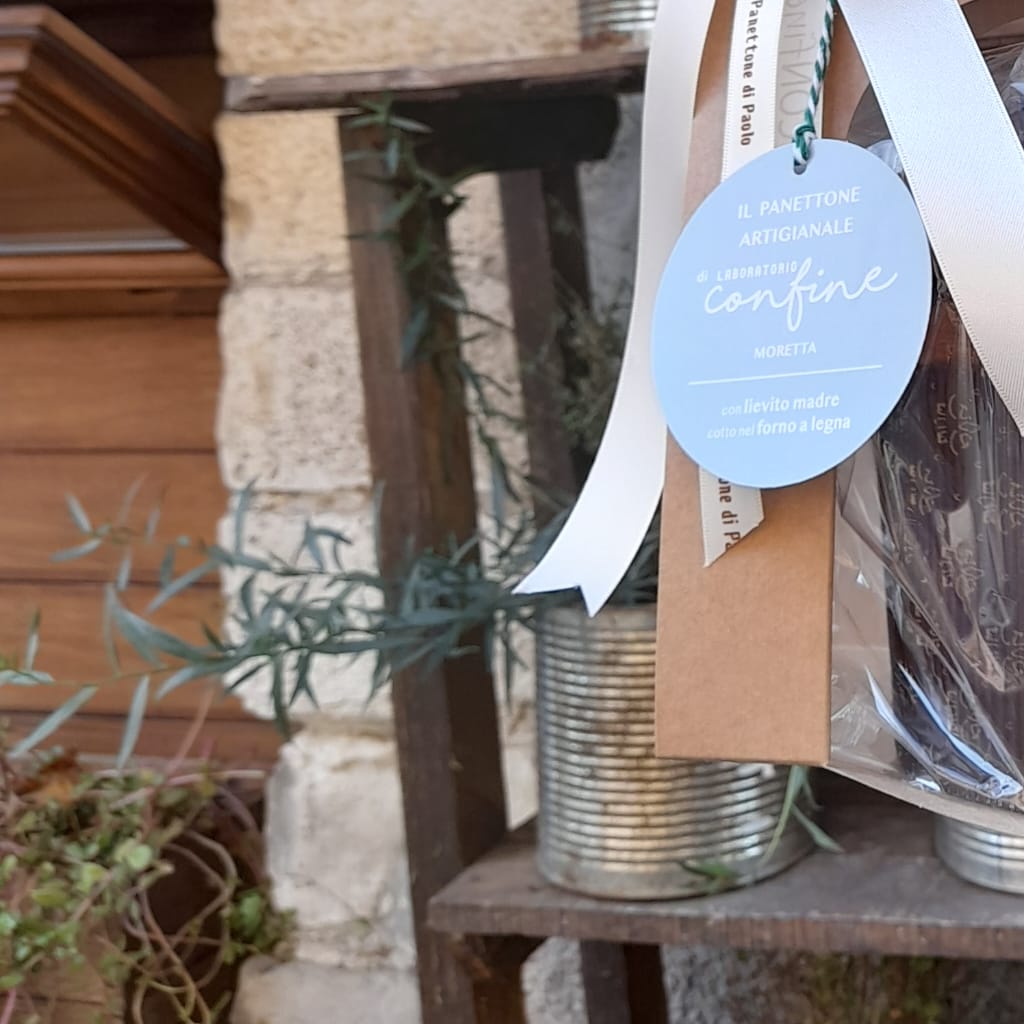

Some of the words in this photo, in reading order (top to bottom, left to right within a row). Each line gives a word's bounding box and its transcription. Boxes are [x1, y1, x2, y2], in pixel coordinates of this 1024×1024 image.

[742, 0, 763, 79] Panettone
[742, 85, 756, 99] di
[740, 101, 756, 147] Paolo
[738, 204, 752, 219] IL
[760, 186, 861, 216] PANETTONE
[739, 217, 854, 247] ARTIGIANALE
[696, 270, 708, 283] di
[717, 261, 798, 281] LABORATORIO
[754, 341, 817, 359] MORETTA
[721, 405, 742, 416] con
[744, 397, 789, 414] lievito
[793, 392, 840, 409] madre
[707, 427, 736, 439] cotto
[738, 425, 755, 437] nel
[757, 419, 797, 435] forno
[800, 420, 808, 432] a
[811, 416, 851, 434] legna
[721, 510, 739, 525] di
